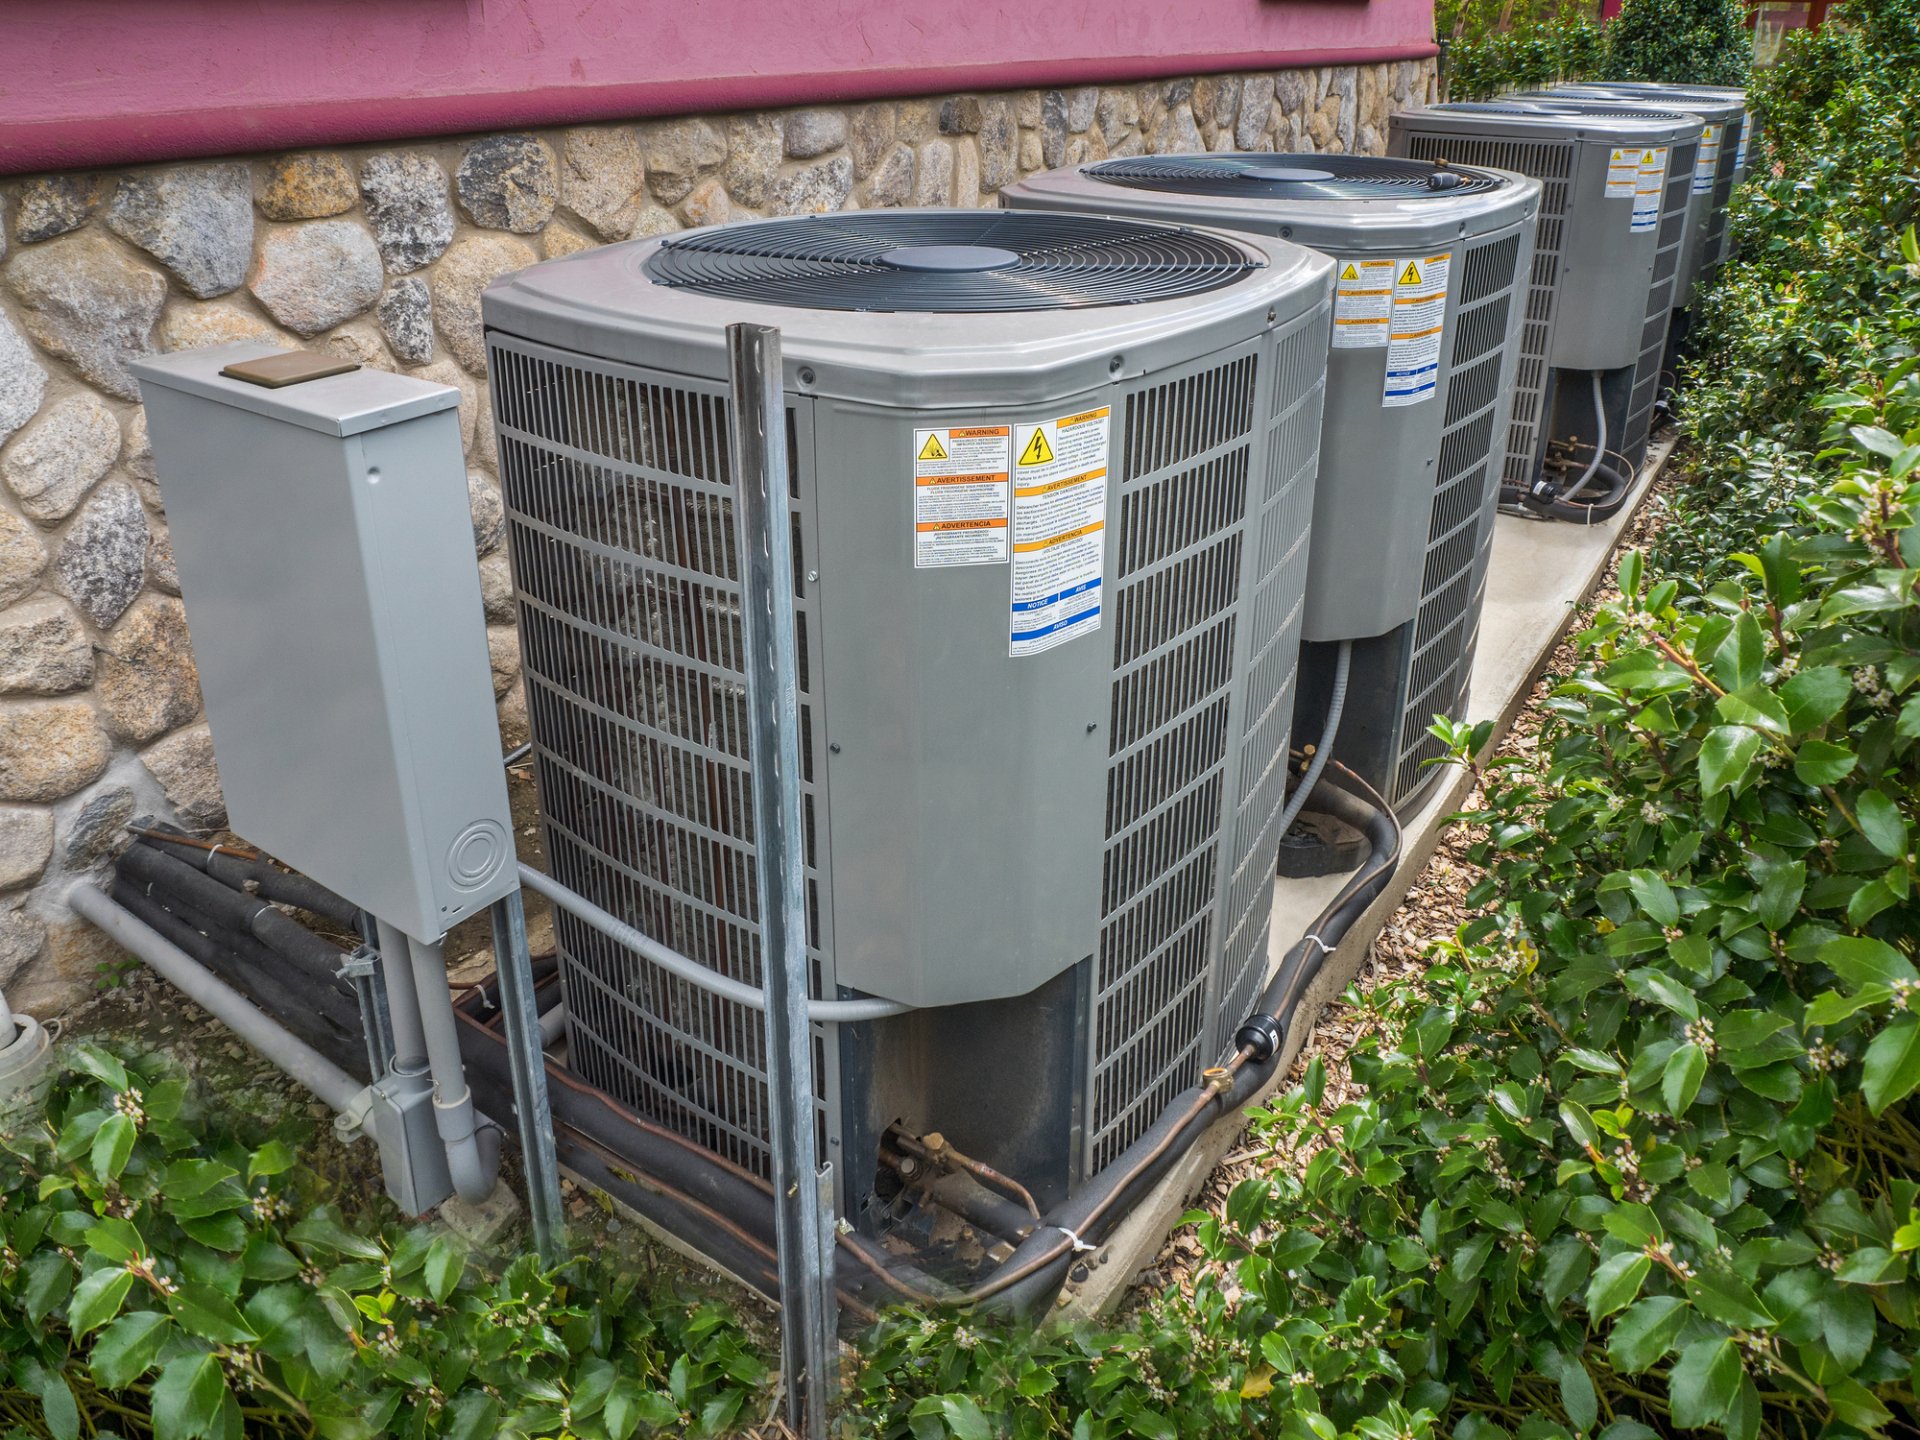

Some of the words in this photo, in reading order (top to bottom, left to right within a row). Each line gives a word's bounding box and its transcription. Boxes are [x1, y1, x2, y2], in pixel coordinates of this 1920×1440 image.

[1074, 413, 1097, 422] WARNING
[937, 475, 995, 483] AVERTISSEMENT
[1047, 475, 1087, 491] AVERTISSEMENT
[1049, 530, 1082, 544] ADVERTENCIA
[1028, 599, 1048, 609] NOTICE
[1075, 584, 1086, 592] AVIS
[1053, 620, 1068, 630] AVISO
